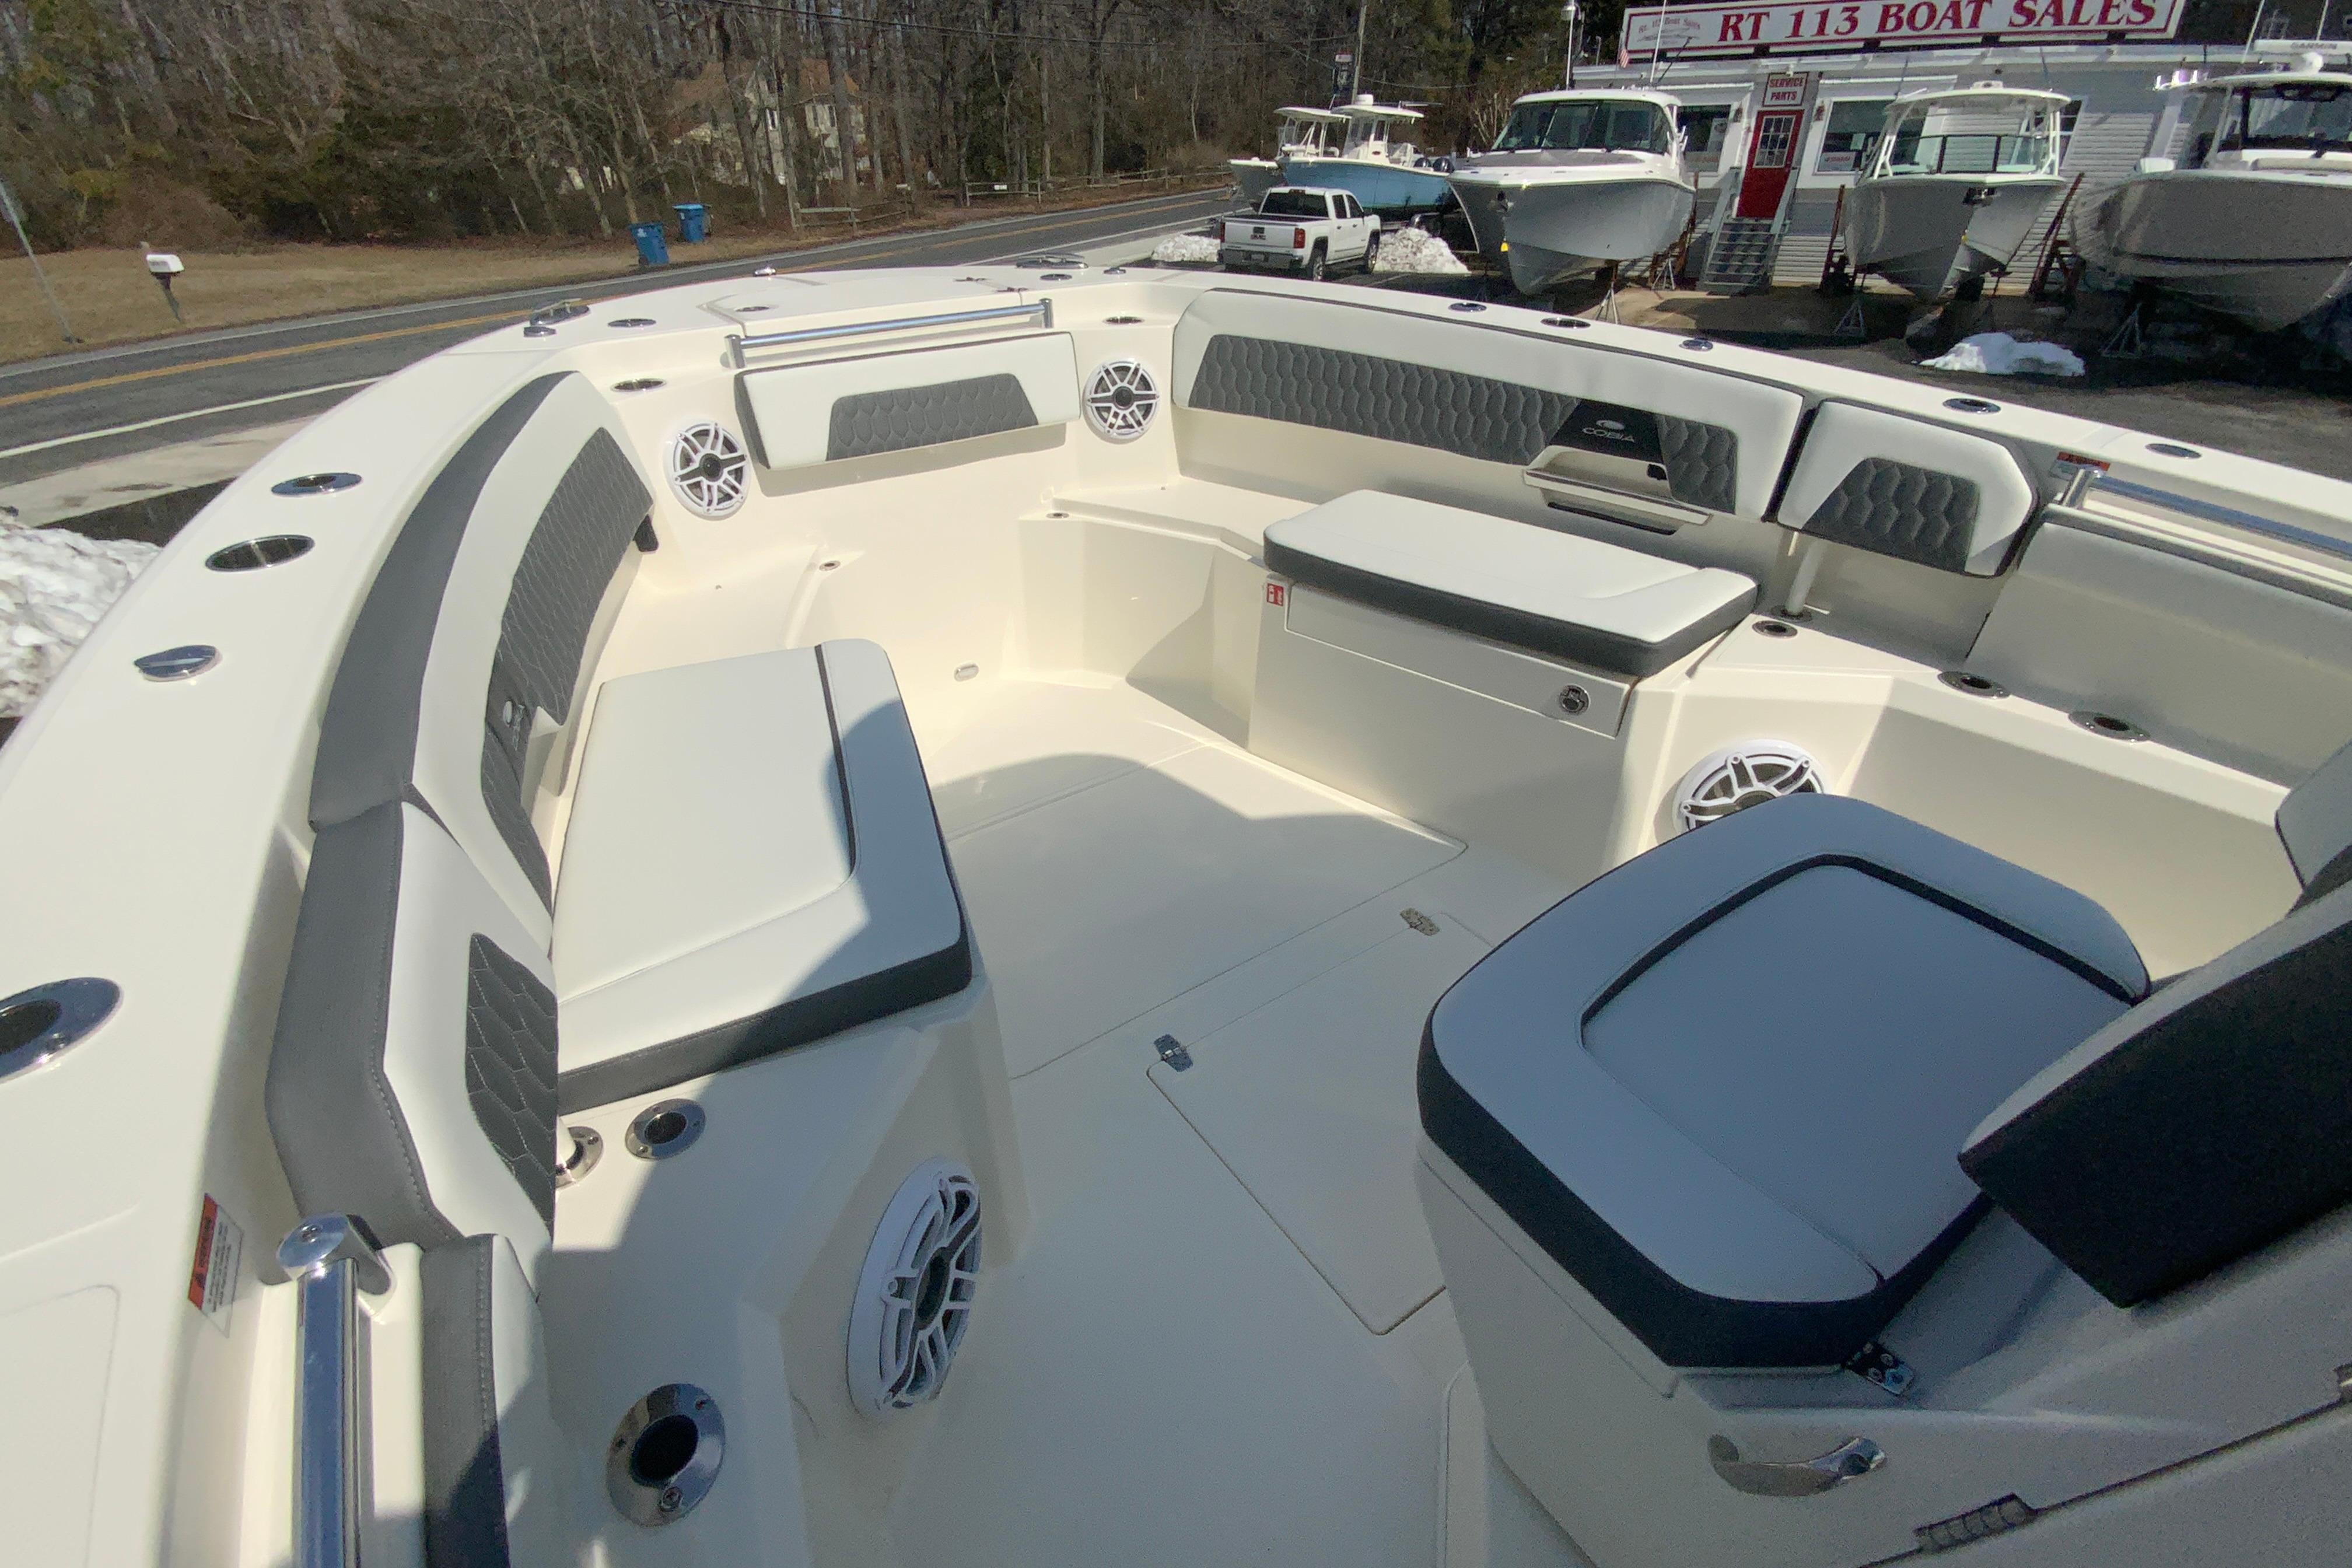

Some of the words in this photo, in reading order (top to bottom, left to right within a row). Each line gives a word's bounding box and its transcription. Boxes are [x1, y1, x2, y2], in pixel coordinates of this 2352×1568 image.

[1718, 12, 1770, 42] RT
[1785, 6, 1860, 38] 113
[1876, 0, 1992, 33] BOAT
[2008, 0, 2157, 27] SALES
[1769, 77, 1803, 88] SERVICE
[1770, 91, 1797, 100] PARTS
[1583, 427, 1634, 442] COBIA
